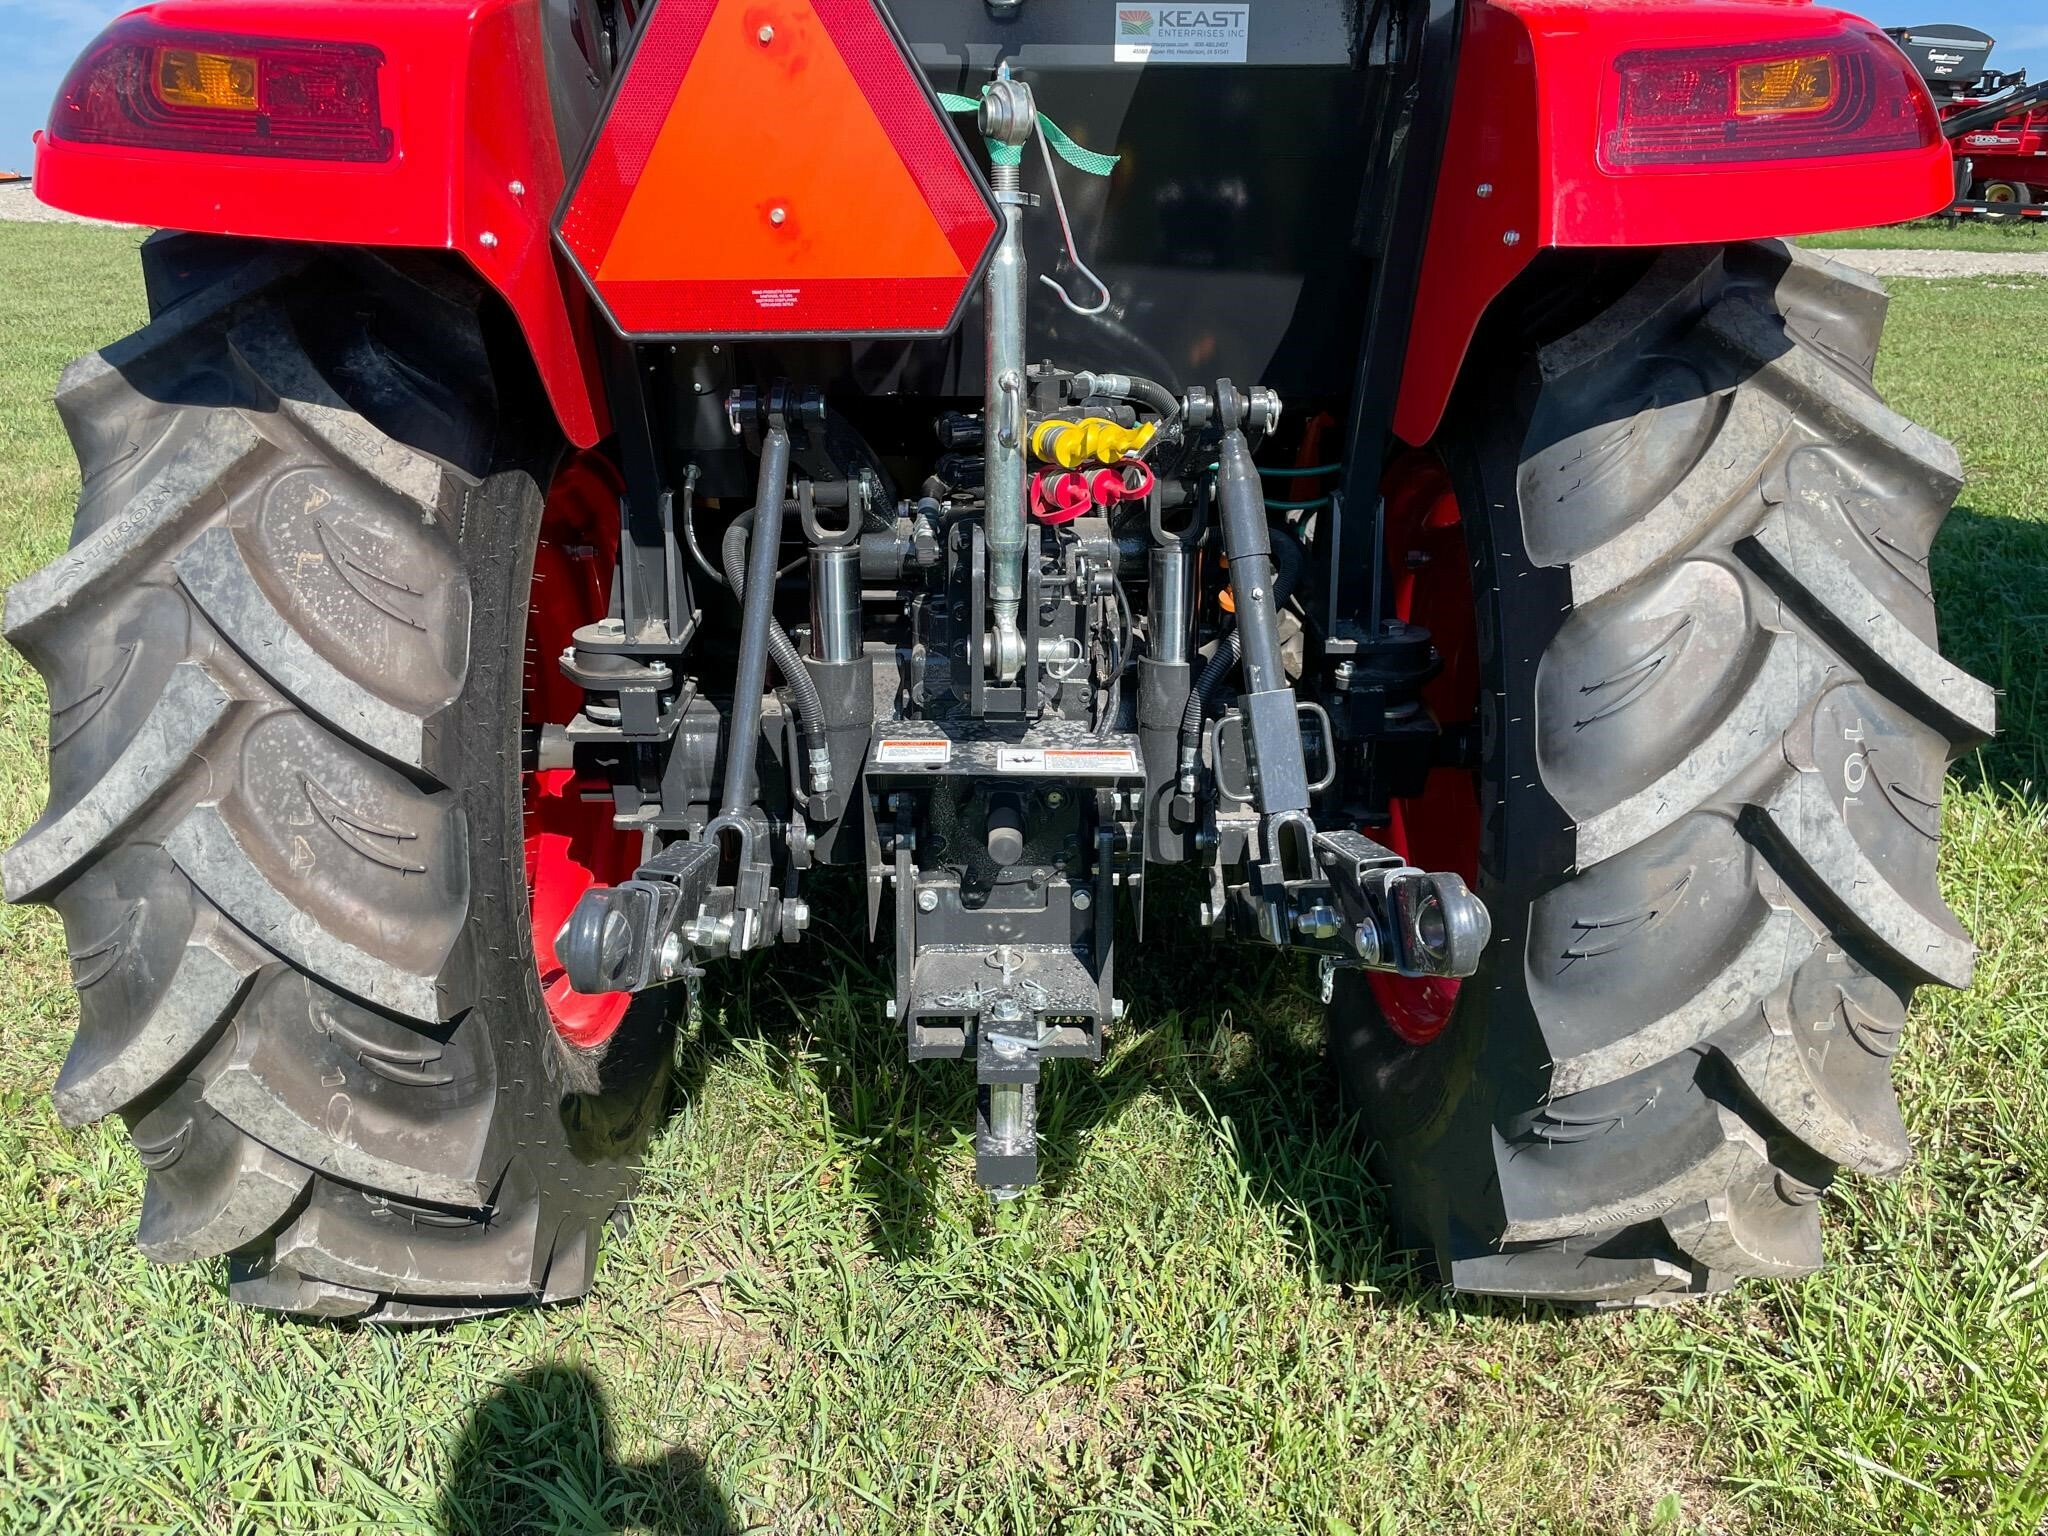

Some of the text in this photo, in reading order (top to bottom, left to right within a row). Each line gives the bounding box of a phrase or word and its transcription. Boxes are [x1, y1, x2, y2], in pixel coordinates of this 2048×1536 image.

[1159, 10, 1245, 27] KEAST
[1158, 29, 1245, 38] ENTERPRISES INC
